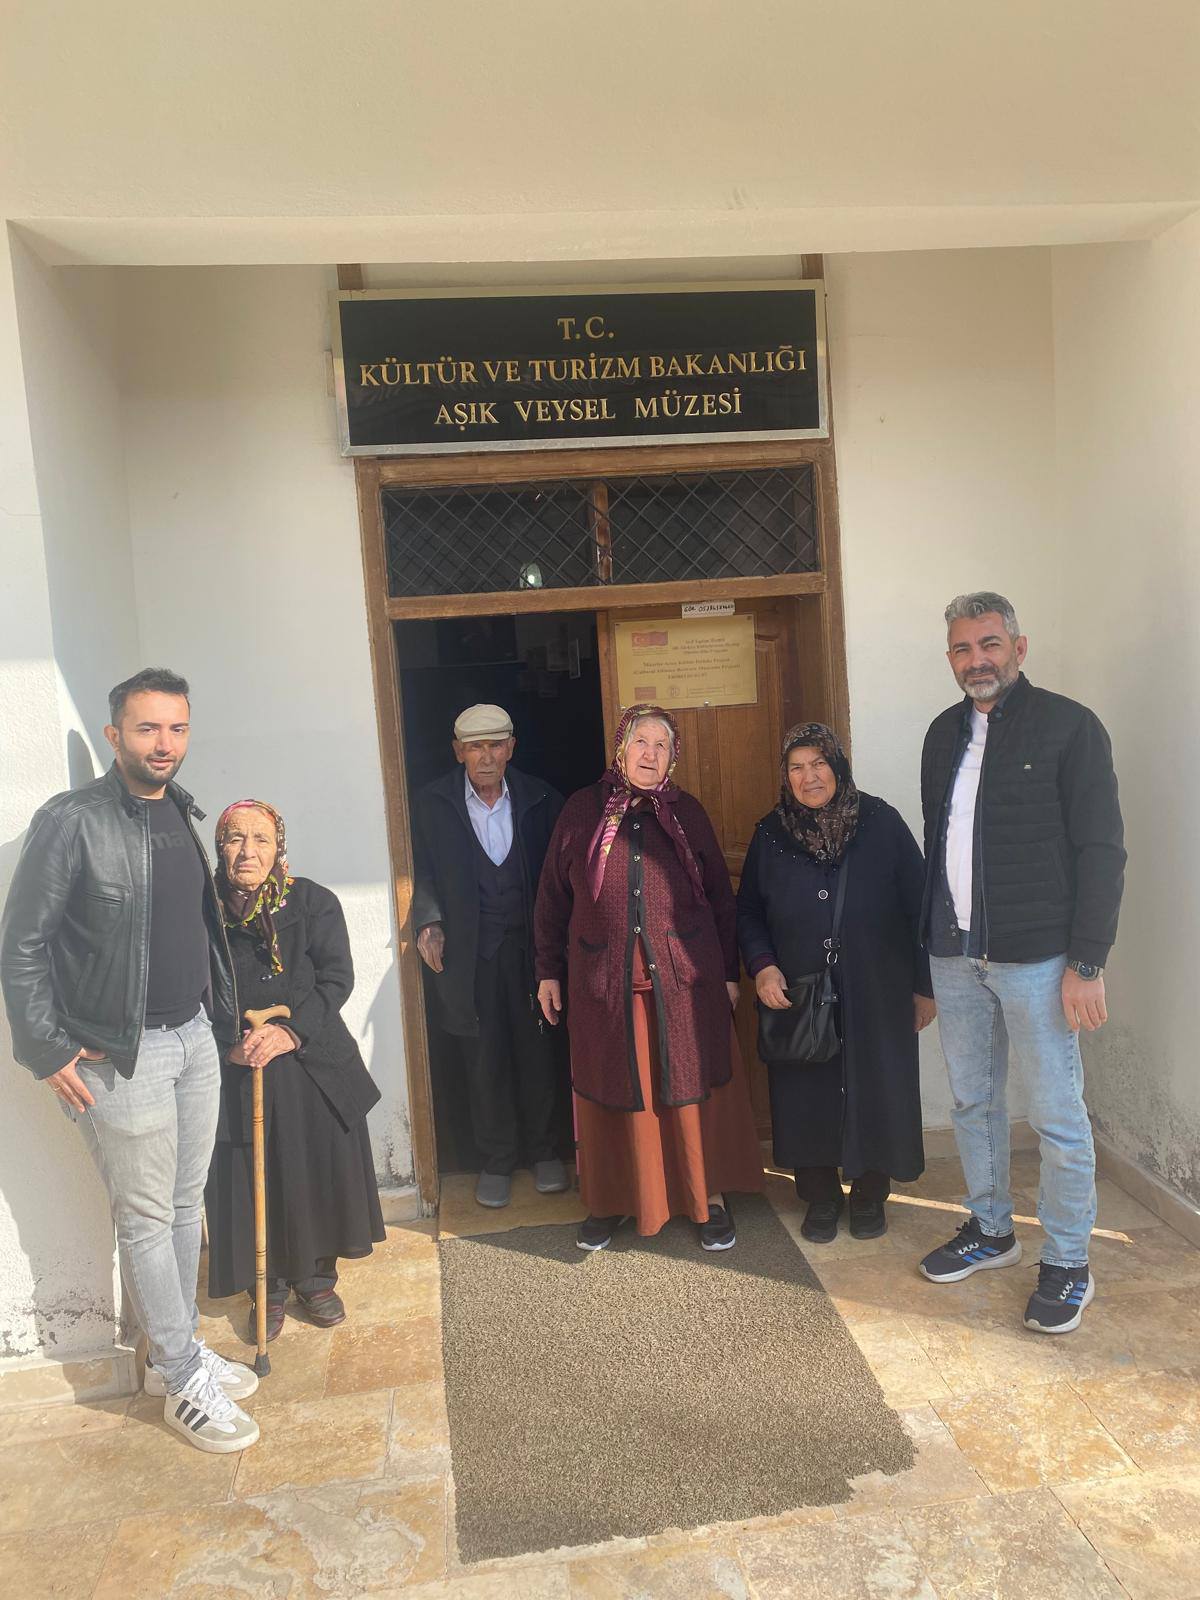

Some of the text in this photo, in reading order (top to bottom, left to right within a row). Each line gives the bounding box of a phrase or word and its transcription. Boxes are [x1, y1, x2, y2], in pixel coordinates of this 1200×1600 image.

[557, 315, 616, 341] T.C.
[360, 345, 808, 387] KÜLTÜR VE TURİZM BAKANLIĞI
[434, 387, 742, 432] AŞIK VEYSEL MÜZESİ
